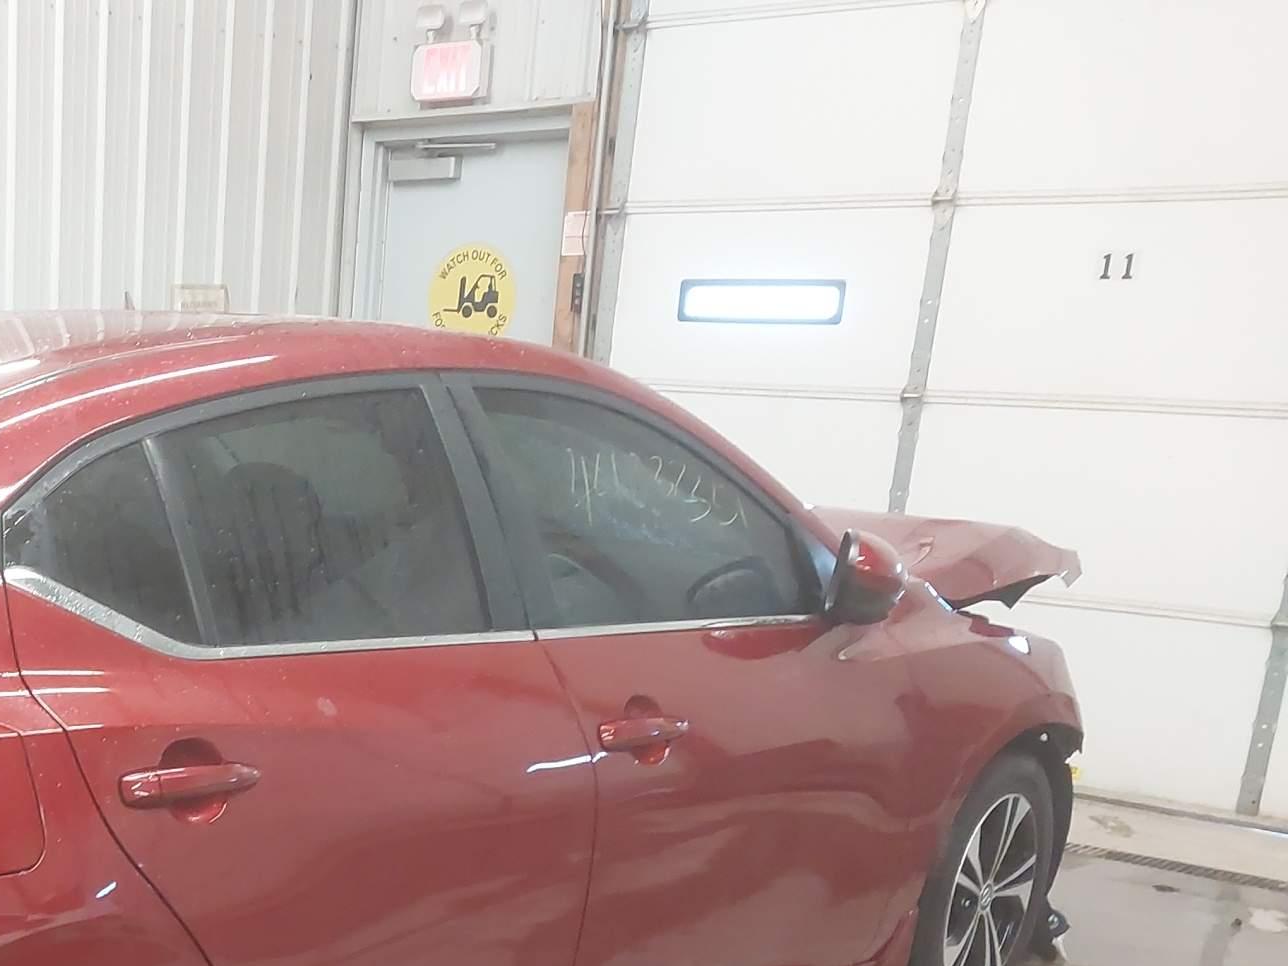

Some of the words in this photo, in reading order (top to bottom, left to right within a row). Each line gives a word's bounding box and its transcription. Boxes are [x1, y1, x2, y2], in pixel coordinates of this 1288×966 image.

[439, 250, 469, 280] WATCH
[471, 248, 491, 263] OUT
[490, 257, 508, 281] FOR
[1099, 252, 1134, 280] 11
